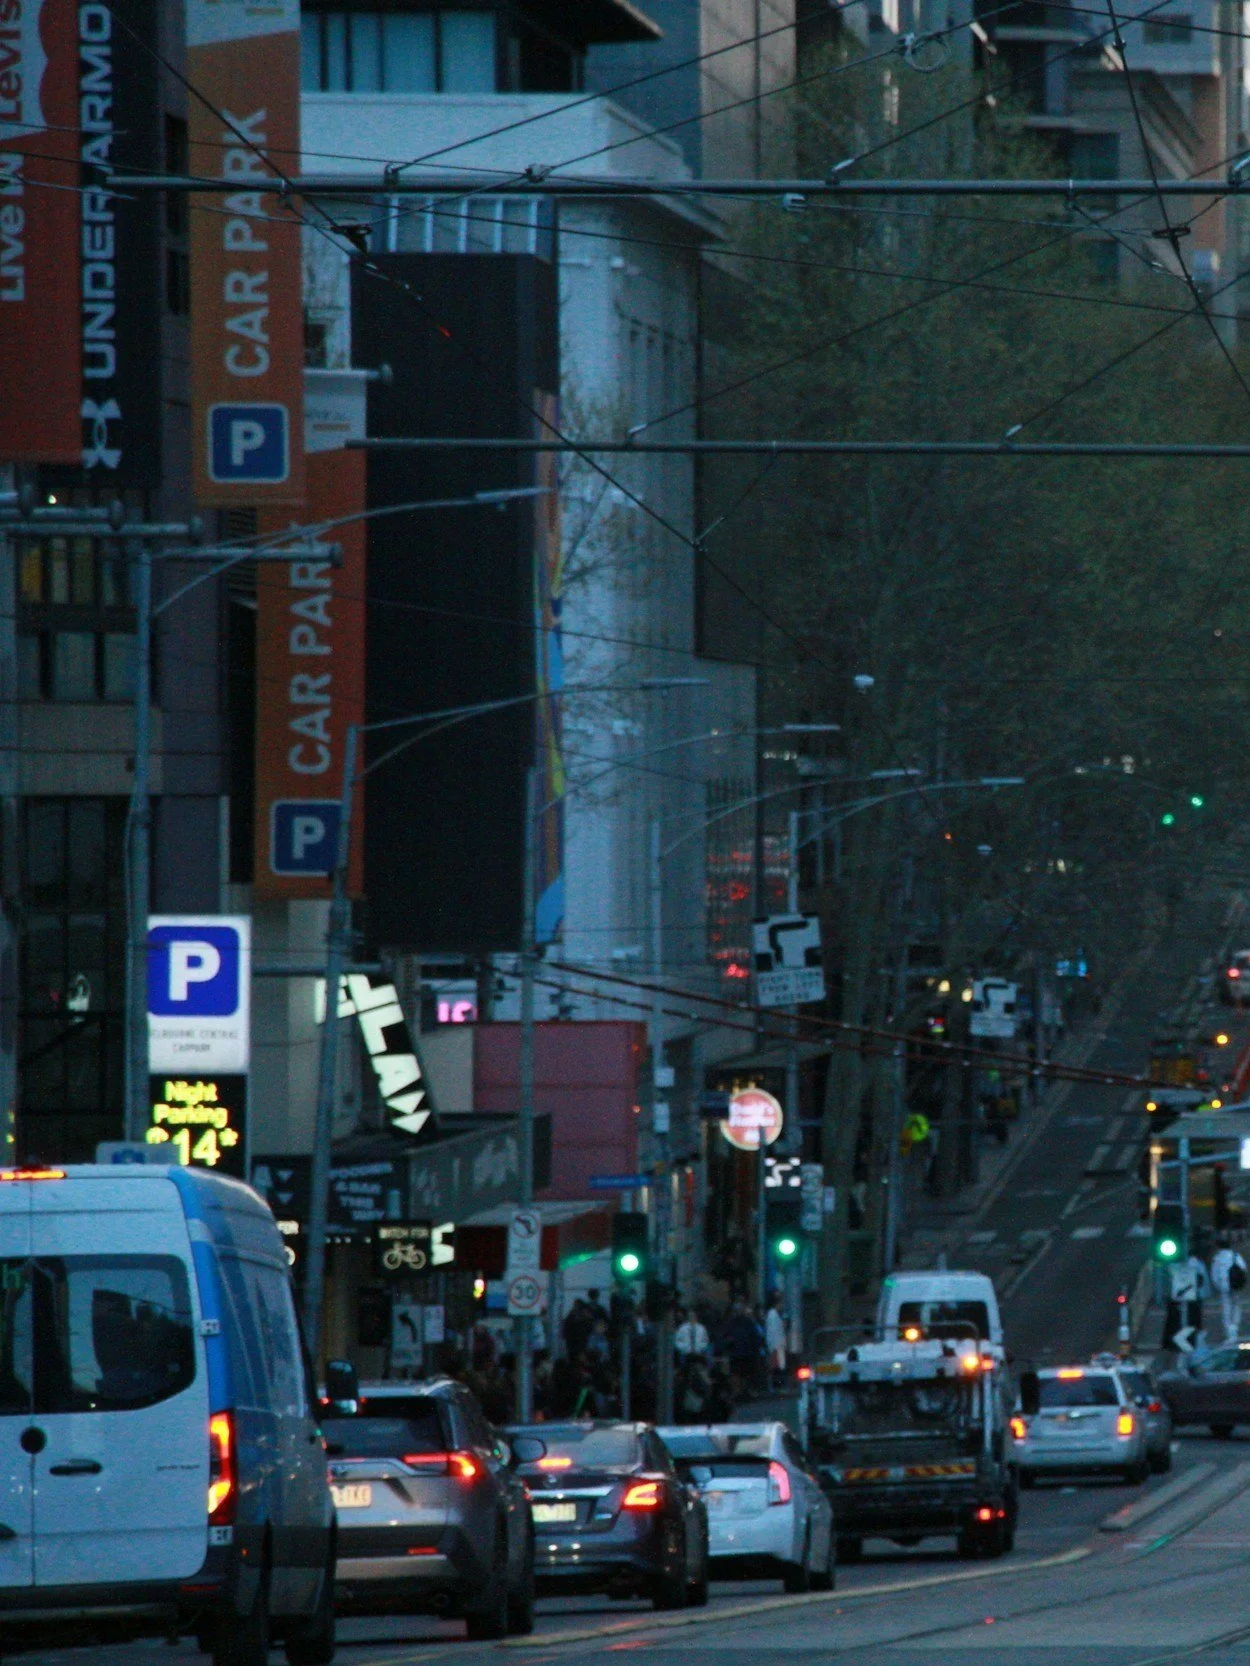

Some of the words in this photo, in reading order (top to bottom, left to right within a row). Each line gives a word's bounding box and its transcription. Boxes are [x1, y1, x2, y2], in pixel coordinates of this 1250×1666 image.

[222, 108, 268, 252] PARK
[81, 185, 117, 380] UNDER
[224, 269, 270, 378] CAR
[230, 420, 266, 466] P
[288, 521, 332, 656] PARK
[288, 672, 332, 775] CAR
[291, 816, 326, 860] P
[169, 941, 221, 1001] P
[153, 1103, 229, 1129] Parking
[165, 1080, 218, 1106] Night
[515, 1286, 536, 1299] 30
